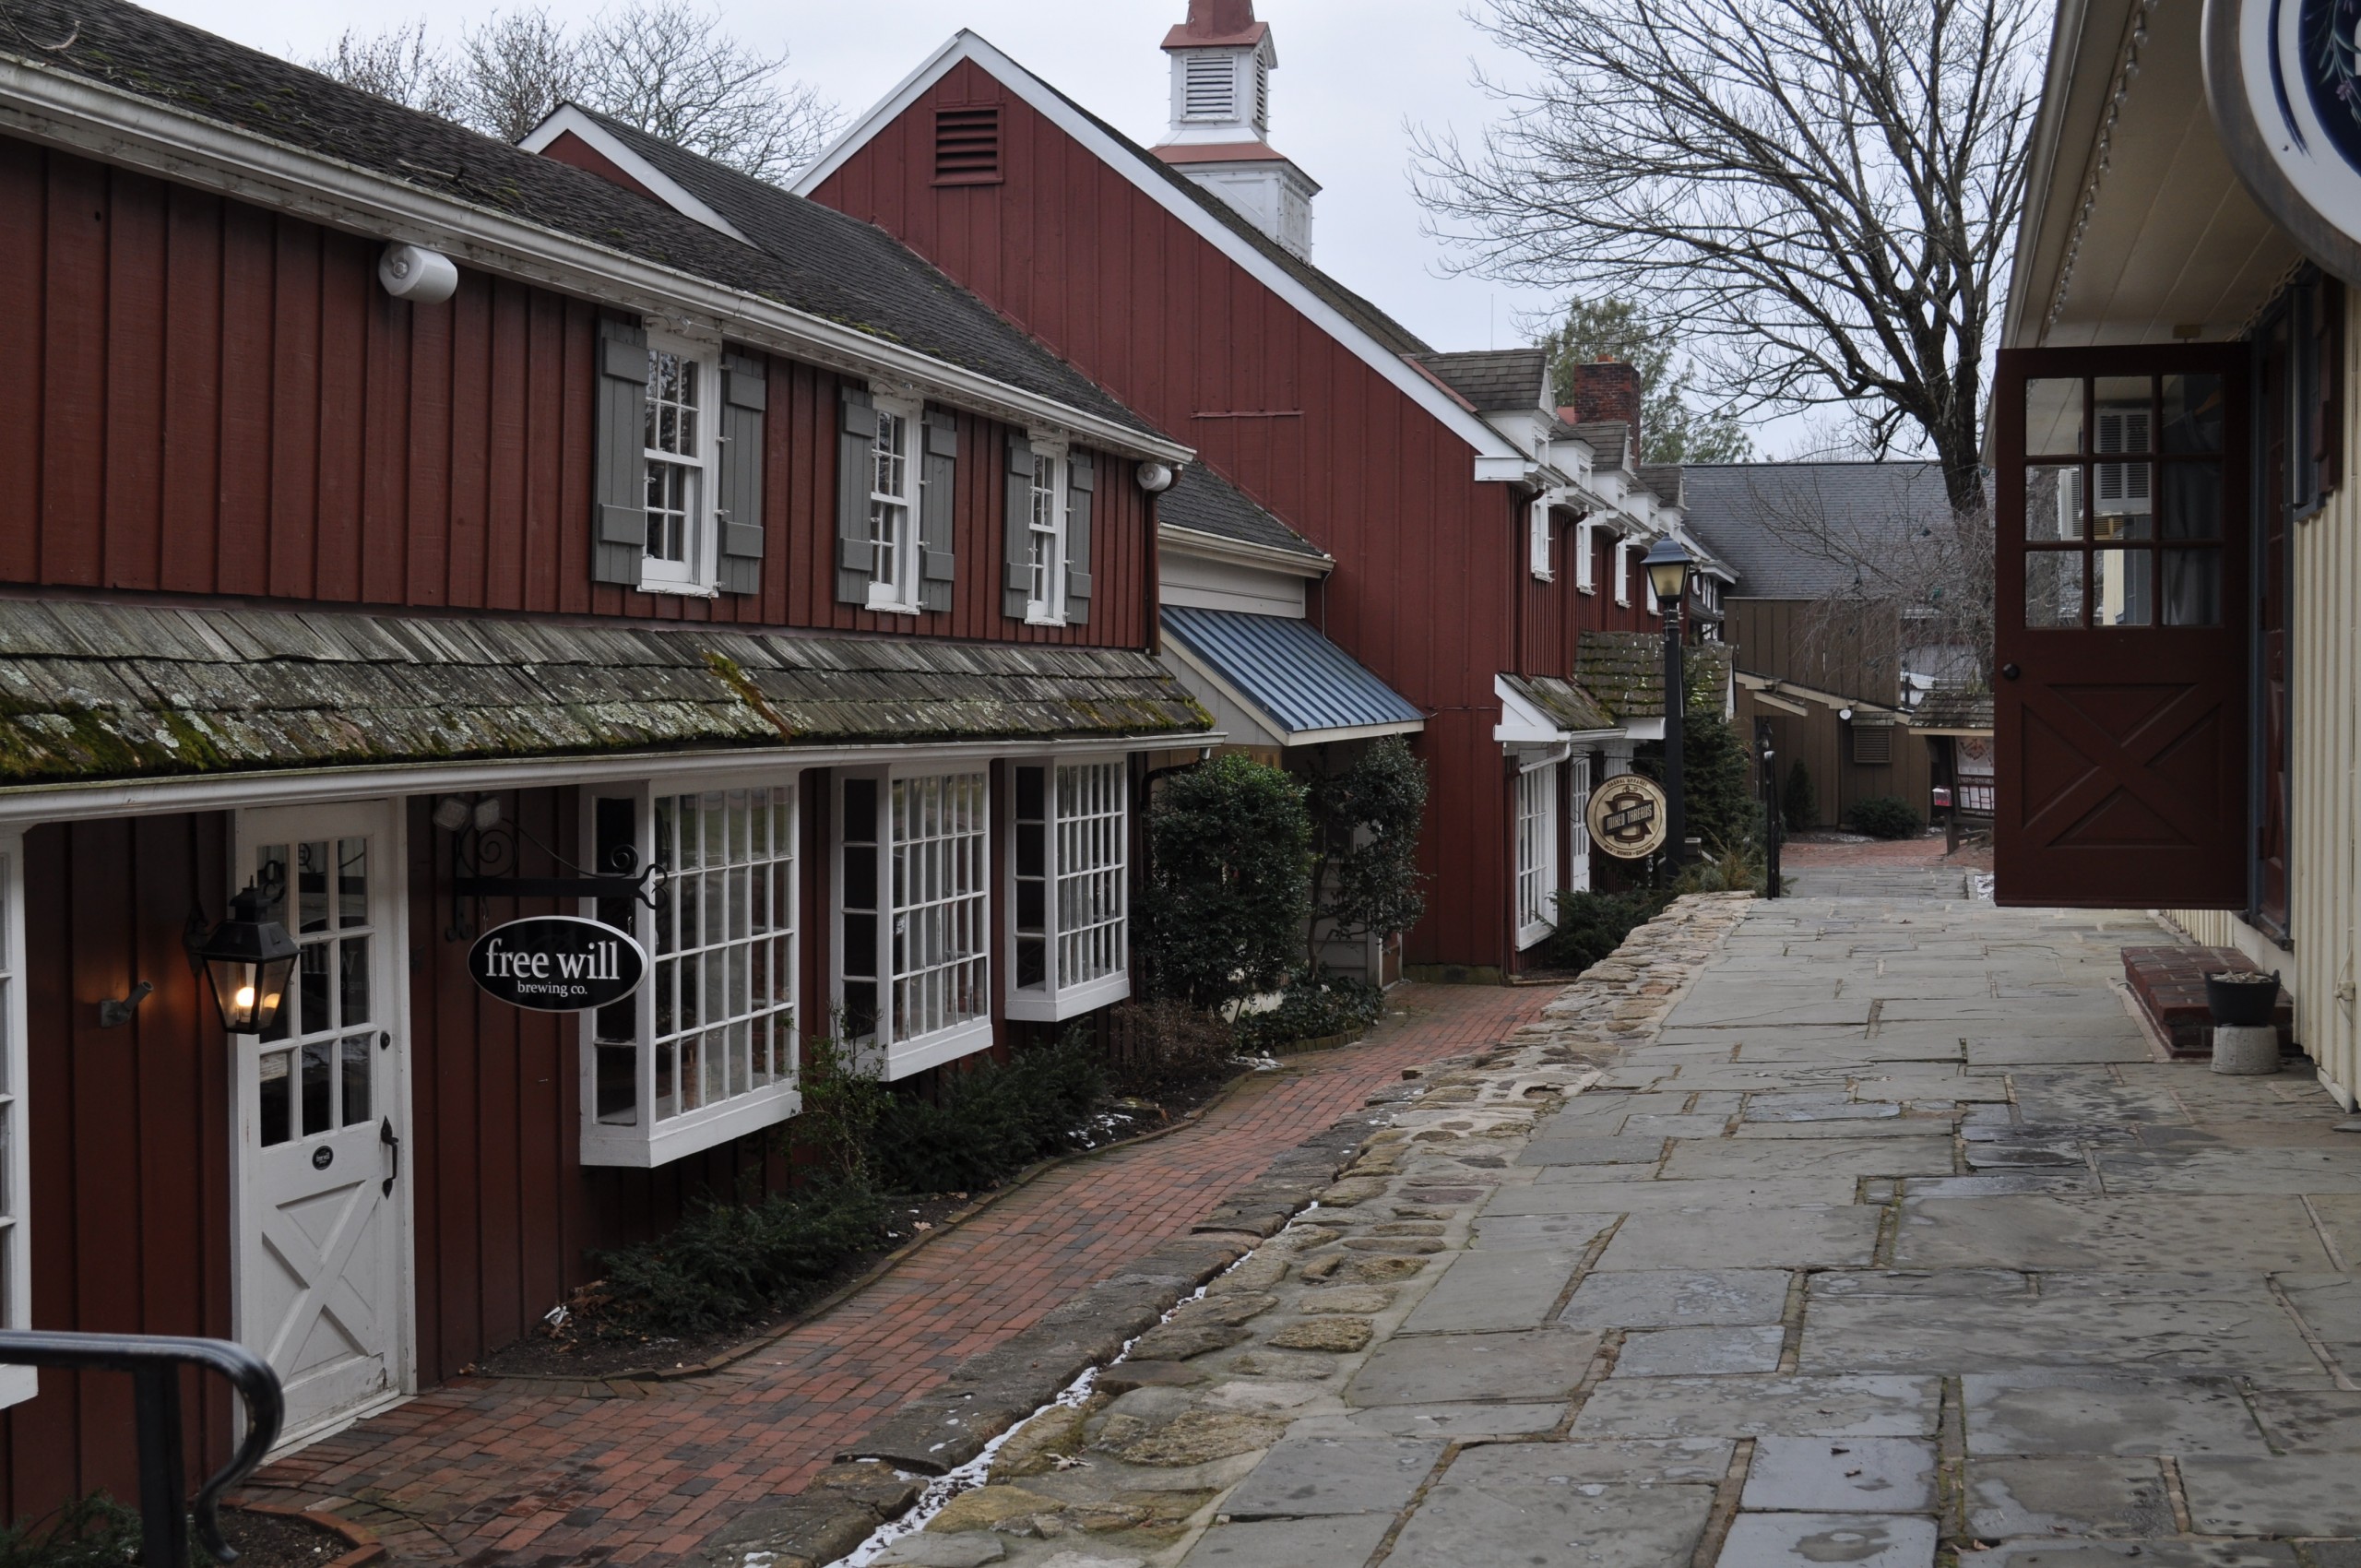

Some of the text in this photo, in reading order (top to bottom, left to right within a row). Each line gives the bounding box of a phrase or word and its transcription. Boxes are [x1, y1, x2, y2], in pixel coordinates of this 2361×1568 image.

[1608, 778, 1647, 788] CASUAL APPAREL
[1607, 804, 1652, 830] MIXED THREADS
[485, 937, 621, 980] free will
[517, 980, 587, 997] brewing co.
